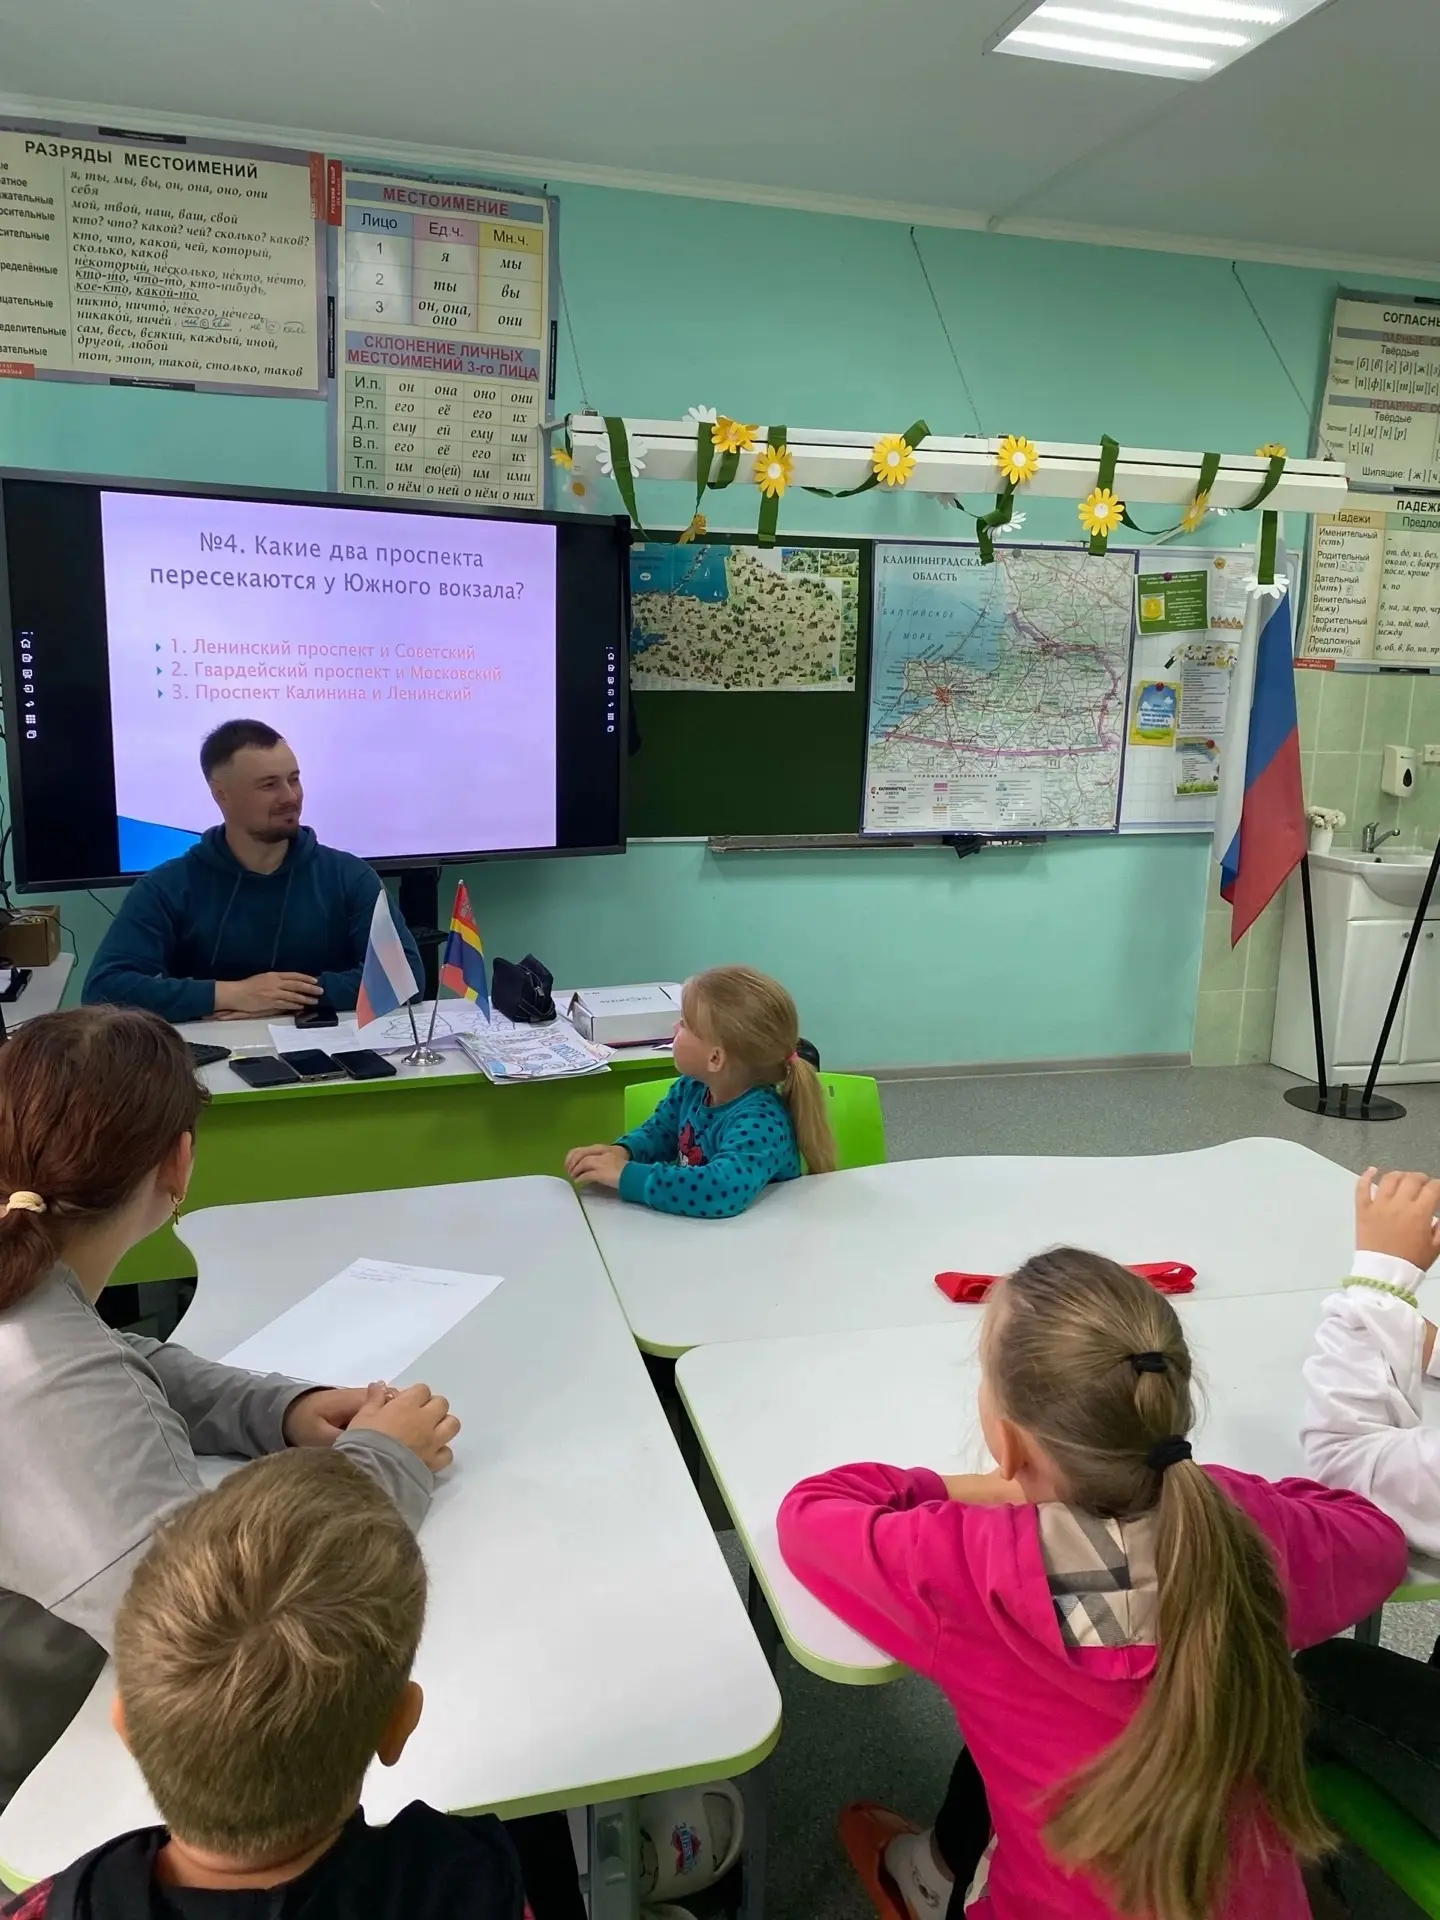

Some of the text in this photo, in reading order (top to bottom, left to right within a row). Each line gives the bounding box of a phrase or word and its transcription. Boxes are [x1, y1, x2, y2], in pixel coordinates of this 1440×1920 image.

[25, 140, 258, 179] РАЗРЯДЫ МЕСТОИМЕНИЙ
[71, 184, 99, 196] себя
[85, 172, 268, 200] ты, мы, вы, он, она, оно, они
[71, 199, 238, 225] мой, твой, наш, ваш, свой
[383, 187, 509, 216] МЕСТОИМЕНИЕ
[72, 215, 310, 247] кто? что? какой? чей? сколько? каков?
[361, 213, 529, 246] Лицо Ед.ч. Мн.ч.
[73, 231, 272, 260] кто, что, какой, чей, который,
[73, 243, 169, 260] сколько, каков
[376, 242, 522, 270] 1 я мы
[75, 269, 267, 297] кто-то, что-то, кто-нибудь,
[76, 281, 198, 300] кое-кто, какой-то
[375, 273, 520, 299] 2 ты вы
[375, 301, 523, 327] 3 он, она, они
[432, 315, 457, 327] оно
[77, 323, 278, 350] сам, весь, всякий, каждый, иной,
[77, 334, 168, 351] другой, любой
[364, 335, 524, 363] СКЛОНЕНИЕ ЛИЧНЫХ
[1381, 344, 1420, 358] Твёрдые
[78, 351, 303, 378] тот, этот, такой, столько, таков
[347, 350, 539, 381] МЕСТОИМЕНИЙ 3-го ЛИЦА
[354, 376, 533, 404] И.п. он она оно они
[354, 396, 528, 423] Р.п. его её его их
[1374, 410, 1412, 423] Твёрдые
[352, 416, 528, 444] Д.п. ему ей ему им
[352, 436, 527, 463] В.п. его её его их
[354, 456, 531, 483] Т.п. им ею(ей) им ими
[352, 476, 536, 502] П.п. нём ней нём них
[1319, 527, 1378, 539] Именительный
[200, 532, 484, 567] №4. Какие два проспекта
[1317, 550, 1370, 561] Родительный
[150, 568, 524, 600] пересекаются у Южного вокзала?
[912, 571, 958, 582] ОБЛАСТЬ
[1315, 574, 1360, 584] Дательный
[1313, 595, 1367, 605] Винительный
[1312, 615, 1368, 626] Творительный
[171, 638, 475, 660] 1. Ленинский проспект и Советский
[903, 632, 933, 641] МОРЕ
[1309, 635, 1361, 646] Предложный
[171, 661, 501, 681] 2. Гвардейский проспект и Московский
[172, 684, 471, 702] 3. Проспект Калинина и Ленинский
